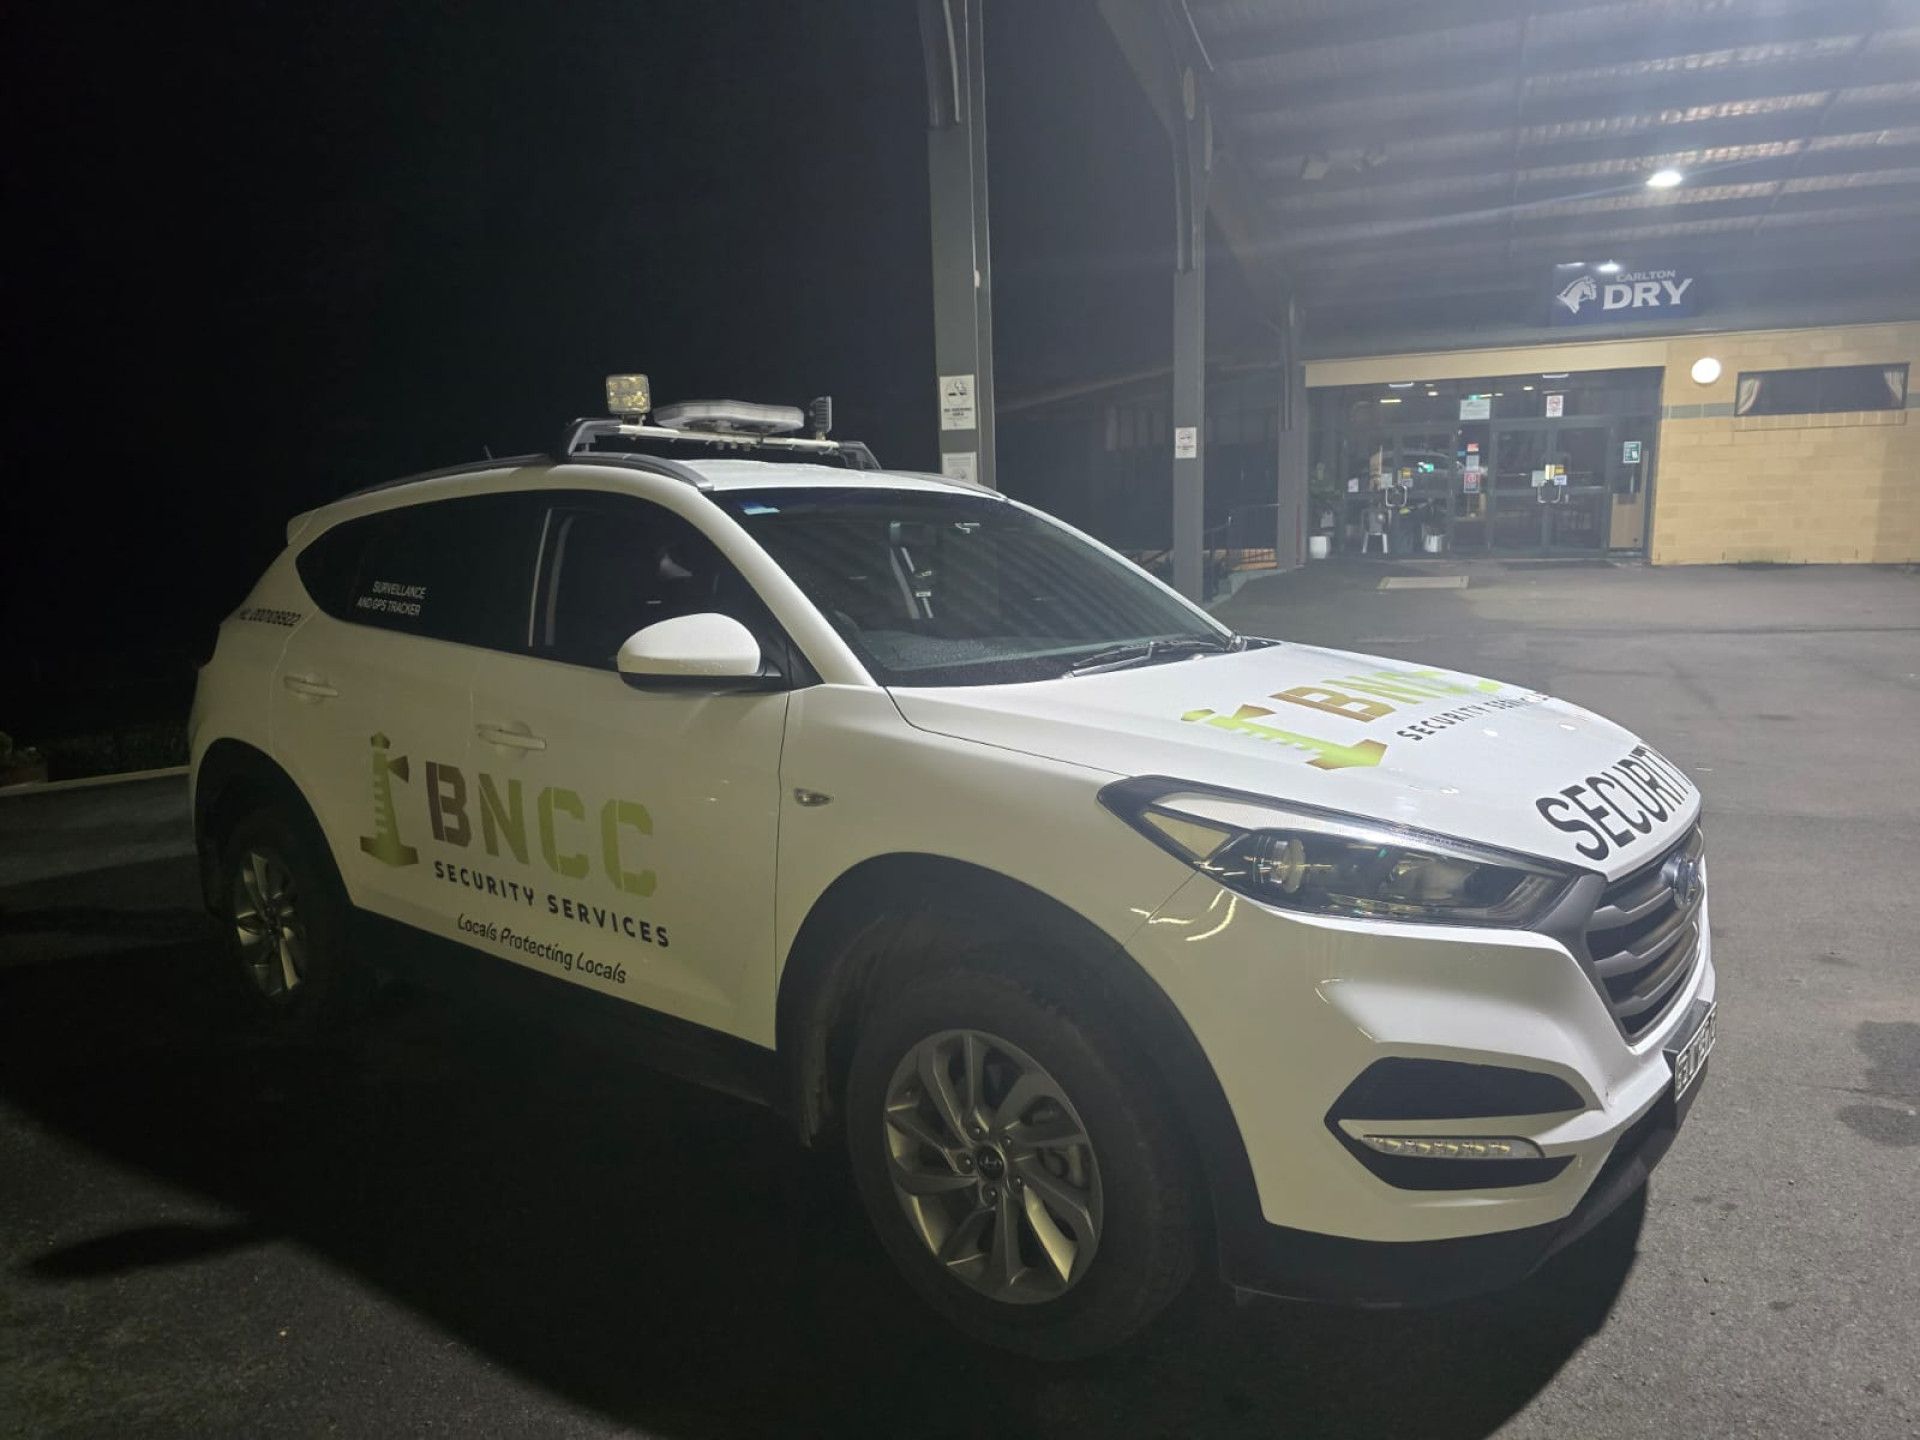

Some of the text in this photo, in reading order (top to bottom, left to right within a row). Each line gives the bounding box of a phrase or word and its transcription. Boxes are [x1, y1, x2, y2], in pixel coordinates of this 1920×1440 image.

[1615, 270, 1676, 282] CARLTON
[1602, 278, 1693, 310] DRY
[372, 580, 427, 599] SURVEILLANCE
[386, 601, 421, 616] TRACKER
[425, 761, 658, 898] BNCC
[433, 860, 670, 948] SECURITY SERVICES
[457, 912, 627, 984] Locals Protecting Locals
